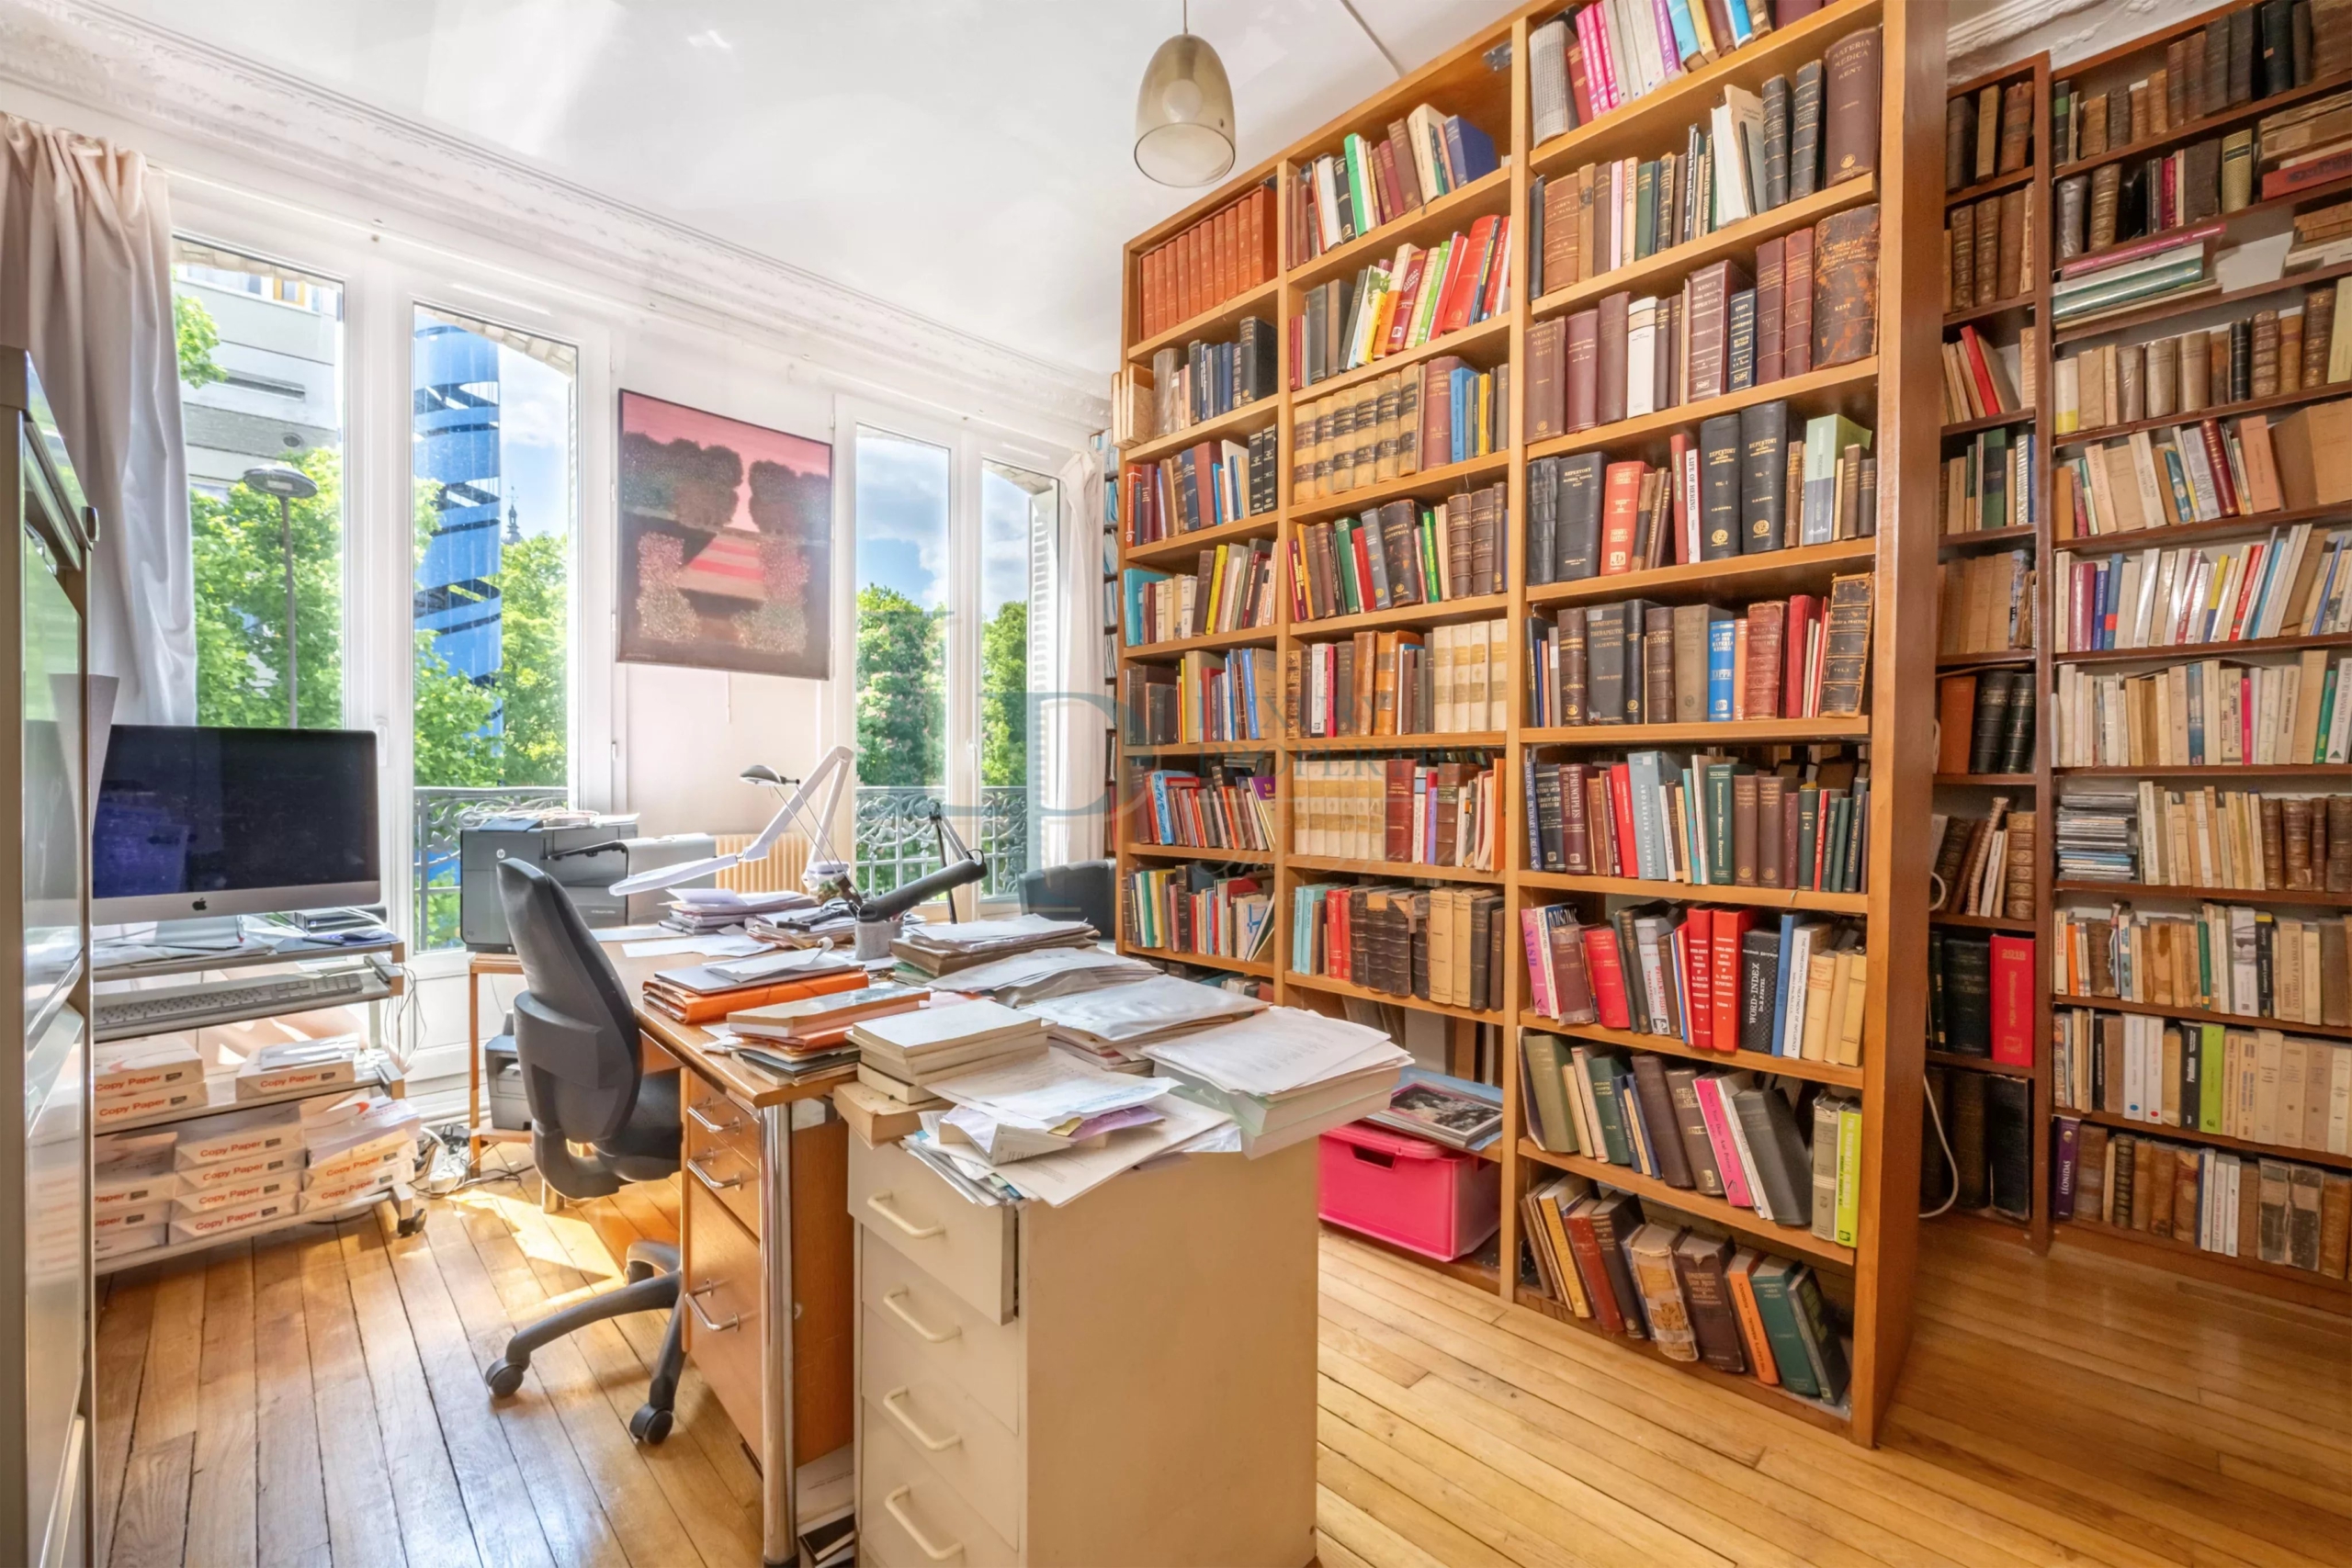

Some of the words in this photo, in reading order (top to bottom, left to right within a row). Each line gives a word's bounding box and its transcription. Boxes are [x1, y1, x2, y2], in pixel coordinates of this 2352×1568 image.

[1709, 448, 1736, 457] REPERTORY
[1749, 437, 1777, 448] REPERTORY
[1690, 474, 1694, 483] OF
[1590, 628, 1624, 637] THERAPEUTICS
[2340, 692, 2348, 716] POUVOIR
[1153, 773, 1161, 792] Best
[1154, 792, 1163, 803] Of
[1569, 773, 1580, 818] PRINCIPLES
[1527, 800, 1536, 829] DICTIONARY
[1640, 784, 1648, 830] REPERTORY
[1157, 804, 1167, 834] Burnett
[1645, 835, 1653, 877] THEMATIC
[1849, 840, 1857, 873] RESPIRATORY
[1525, 930, 1537, 966] NASH
[96, 1080, 124, 1093] Copy
[129, 1073, 162, 1087] Paper
[260, 1077, 286, 1089] Copy
[288, 1073, 318, 1086] Paper
[99, 1105, 129, 1117] Copy
[132, 1097, 165, 1111] Paper
[199, 1146, 228, 1157] Copy
[230, 1140, 262, 1152] Paper
[1845, 1132, 1854, 1172] RHEUMATIC
[202, 1170, 230, 1181] Copy
[233, 1163, 265, 1175] Paper
[326, 1166, 350, 1177] Copy
[353, 1156, 380, 1168] Paper
[198, 1194, 226, 1205] Copy
[230, 1186, 260, 1199] Paper
[321, 1189, 346, 1200] Copy
[349, 1179, 375, 1192] Paper
[1843, 1174, 1851, 1209] REMEDIES
[95, 1216, 121, 1227] aper
[195, 1220, 224, 1231] Copy
[226, 1211, 257, 1224] Paper
[1564, 1253, 1578, 1286] WORLD
